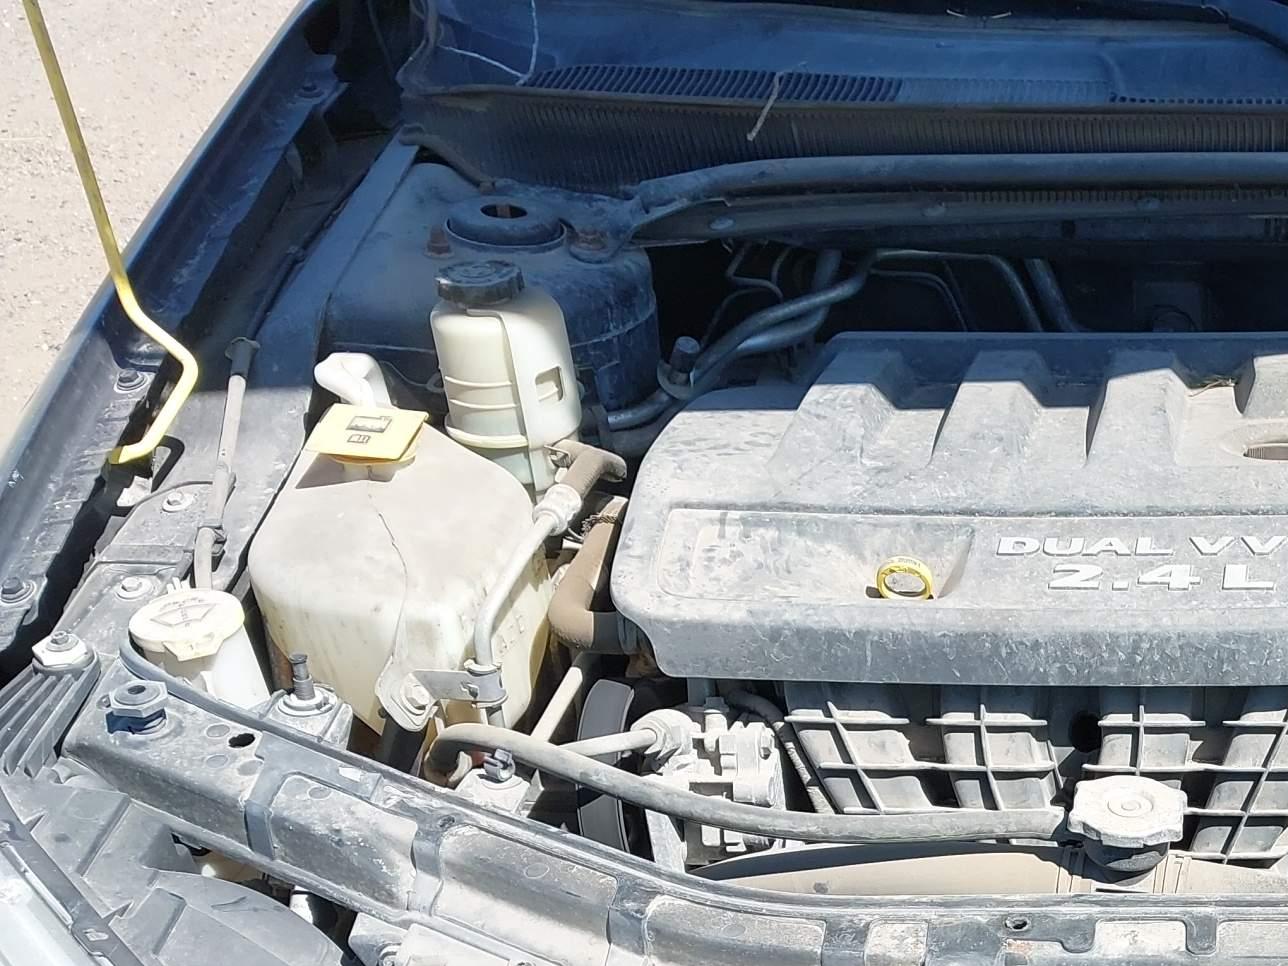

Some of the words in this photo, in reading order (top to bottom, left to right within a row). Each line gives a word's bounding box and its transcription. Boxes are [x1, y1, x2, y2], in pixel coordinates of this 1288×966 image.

[996, 536, 1174, 557] DUAL
[1047, 563, 1201, 592] 2.4
[1221, 563, 1275, 592] L
